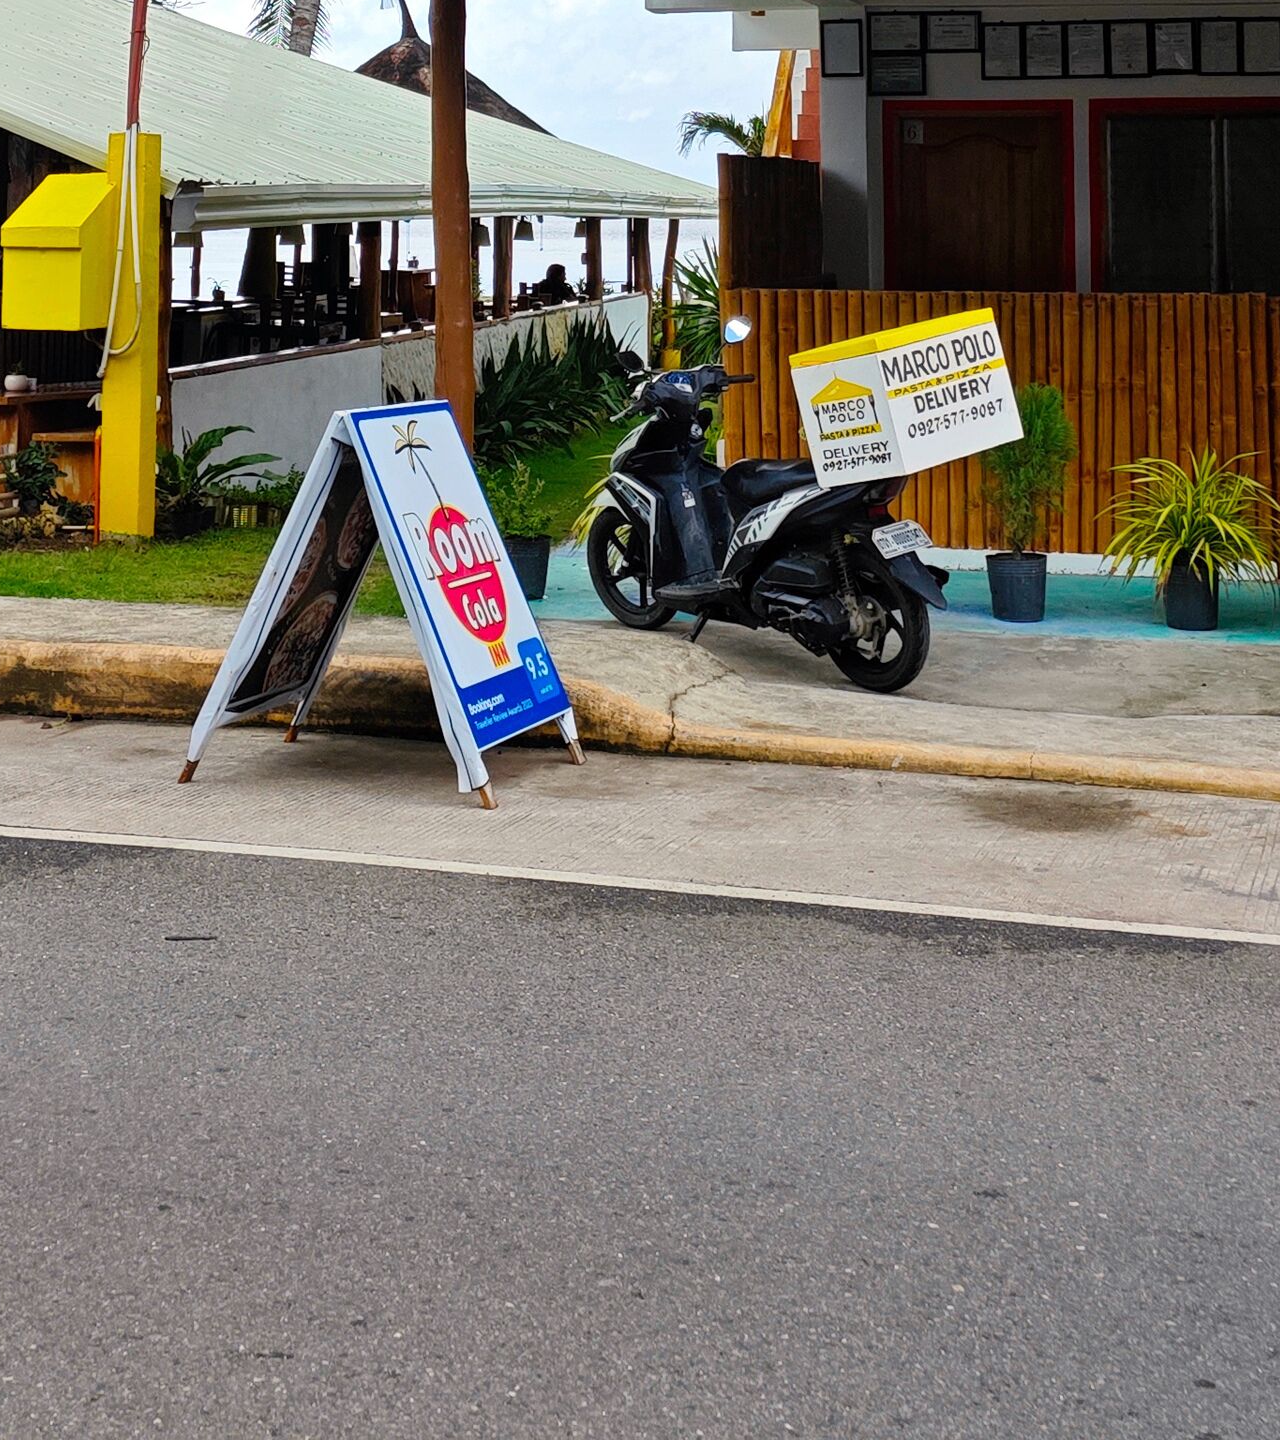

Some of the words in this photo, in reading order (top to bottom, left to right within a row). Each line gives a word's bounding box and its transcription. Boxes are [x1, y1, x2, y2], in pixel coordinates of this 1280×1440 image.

[881, 343, 950, 387] MARCO
[951, 330, 996, 367] POLO
[893, 380, 933, 398] PASTA
[945, 363, 992, 382] PIZZA
[913, 374, 992, 414] DELIVERY
[821, 398, 866, 415] MARCO
[829, 410, 865, 424] POLO
[907, 398, 1003, 439] 0927-577-9087
[820, 430, 844, 441] PASTA
[851, 425, 877, 437] PIZZA
[822, 452, 892, 472] 0927-577-9087
[823, 440, 889, 460] DELIVERY
[402, 512, 501, 580] Room
[461, 588, 503, 631] Cola
[488, 641, 511, 667] INN
[525, 651, 549, 680] 9.5
[467, 693, 505, 716] Booking.com
